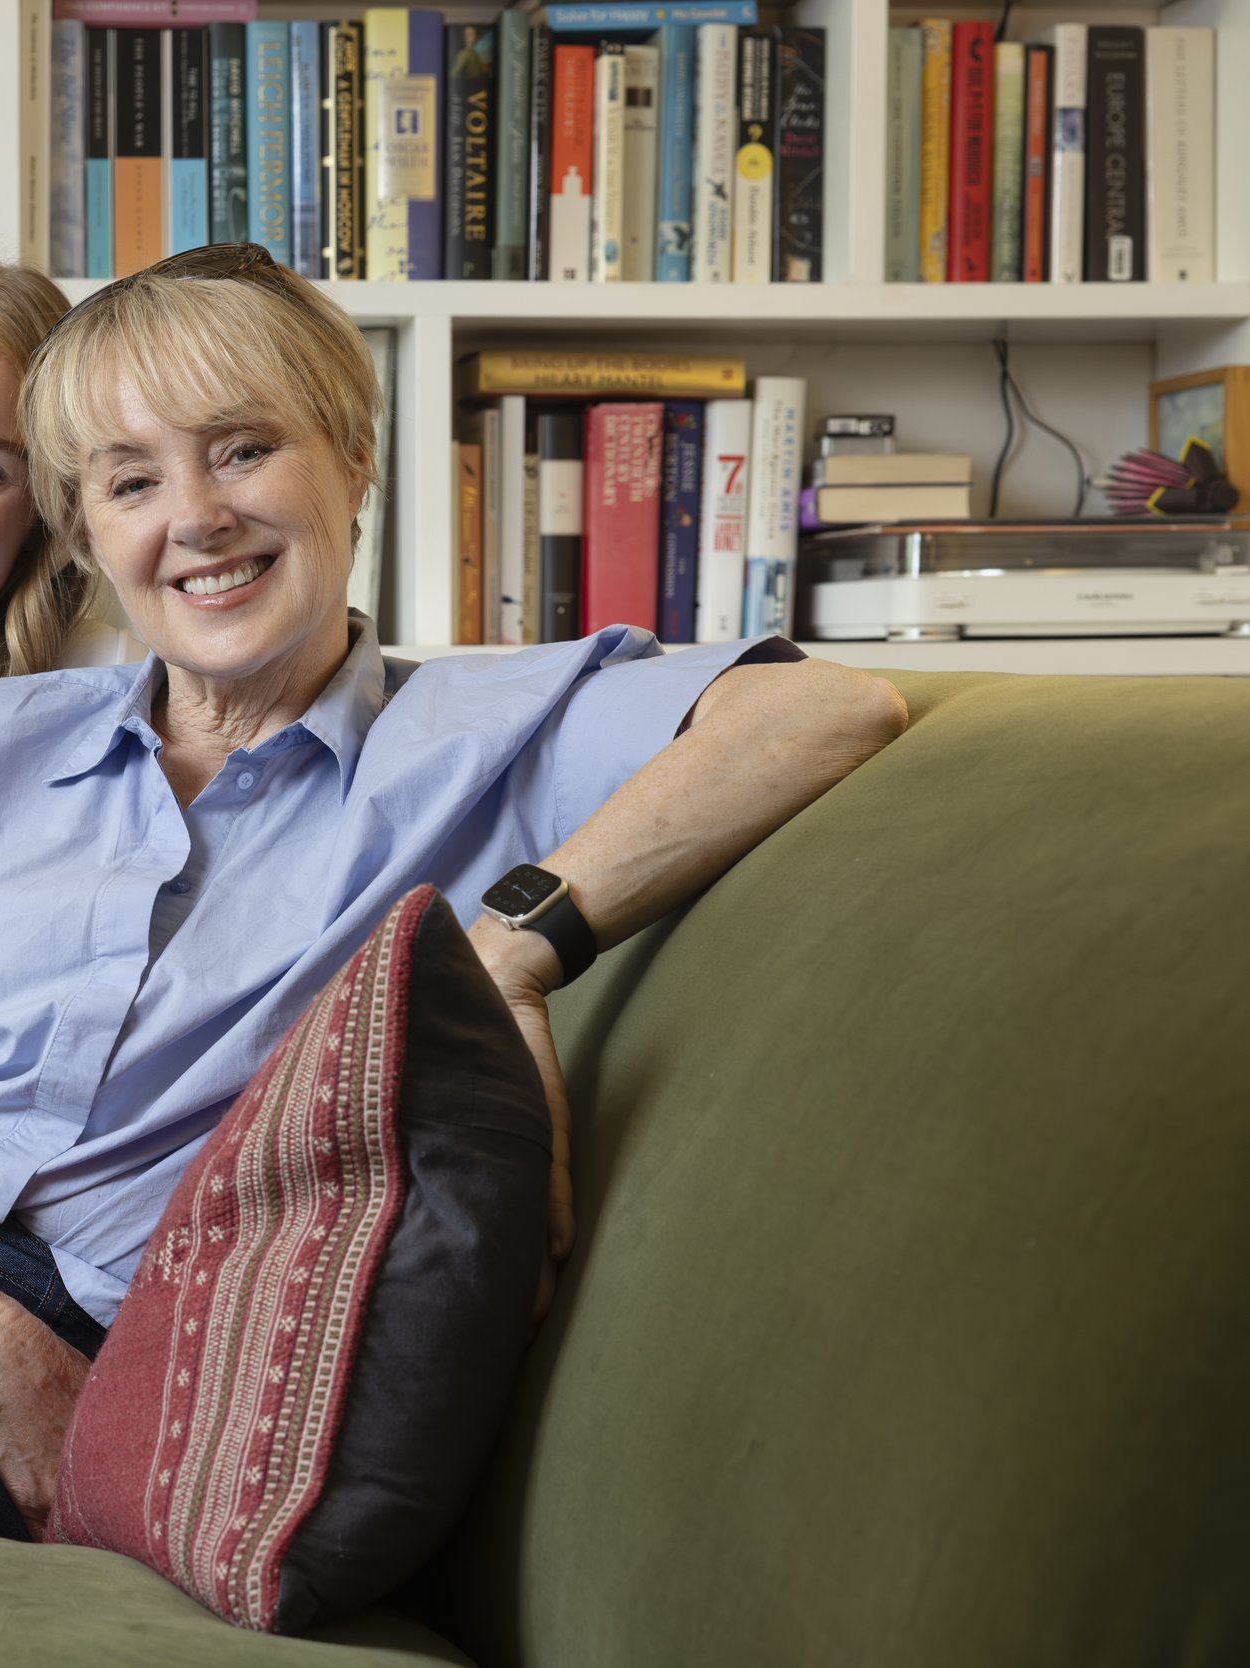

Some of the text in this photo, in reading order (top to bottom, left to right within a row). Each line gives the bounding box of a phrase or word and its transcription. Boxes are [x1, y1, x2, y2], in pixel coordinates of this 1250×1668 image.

[134, 38, 144, 148] THE PEOPLE'S WAR
[229, 58, 240, 156] DAVID MITCHELL
[1106, 72, 1126, 148] EUROPE
[256, 42, 285, 242] LEIGH FERMOR
[338, 80, 351, 252] A GENTLEMAN IN MOSCOW
[464, 90, 486, 240] VOLTAIRE
[510, 357, 691, 372] BRING UP THE BODIES
[534, 374, 664, 389] HILARY MANTEL
[604, 415, 616, 506] DICTIONARY
[618, 414, 630, 483] CENTURY
[630, 415, 644, 502] TWENTIETH
[664, 432, 678, 502] BURTON
[681, 442, 695, 492] JESSIE
[780, 408, 795, 532] MARTIN AMIS
